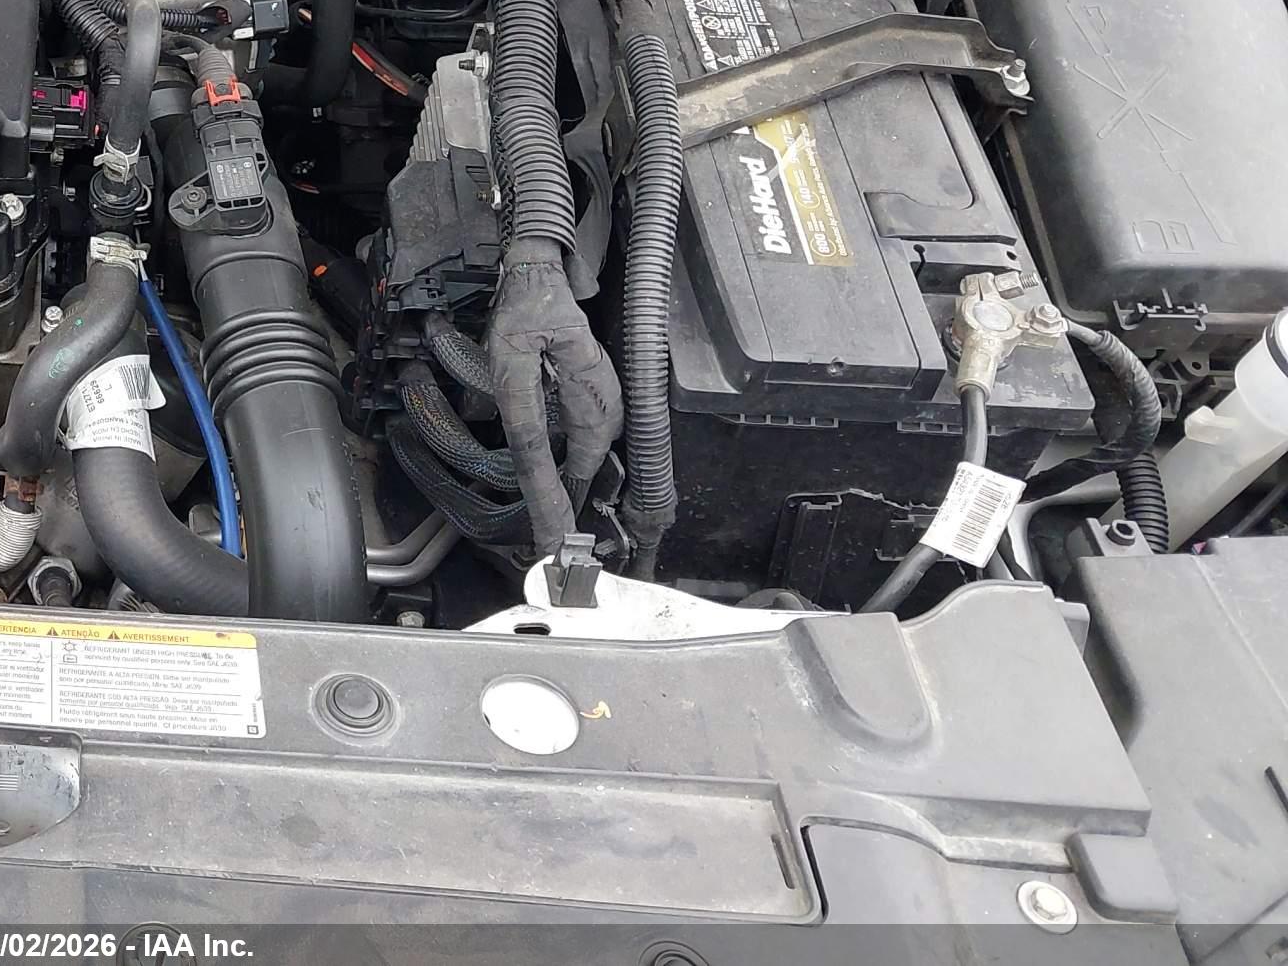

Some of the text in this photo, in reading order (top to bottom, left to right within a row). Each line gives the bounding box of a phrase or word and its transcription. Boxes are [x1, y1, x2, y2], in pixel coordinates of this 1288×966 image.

[739, 155, 792, 254] DieHard
[799, 187, 813, 204] 140
[815, 234, 830, 253] 800
[91, 380, 104, 404] 66629
[61, 628, 100, 639] ATENÇÃO
[122, 632, 190, 643] AVERTISSEMENT
